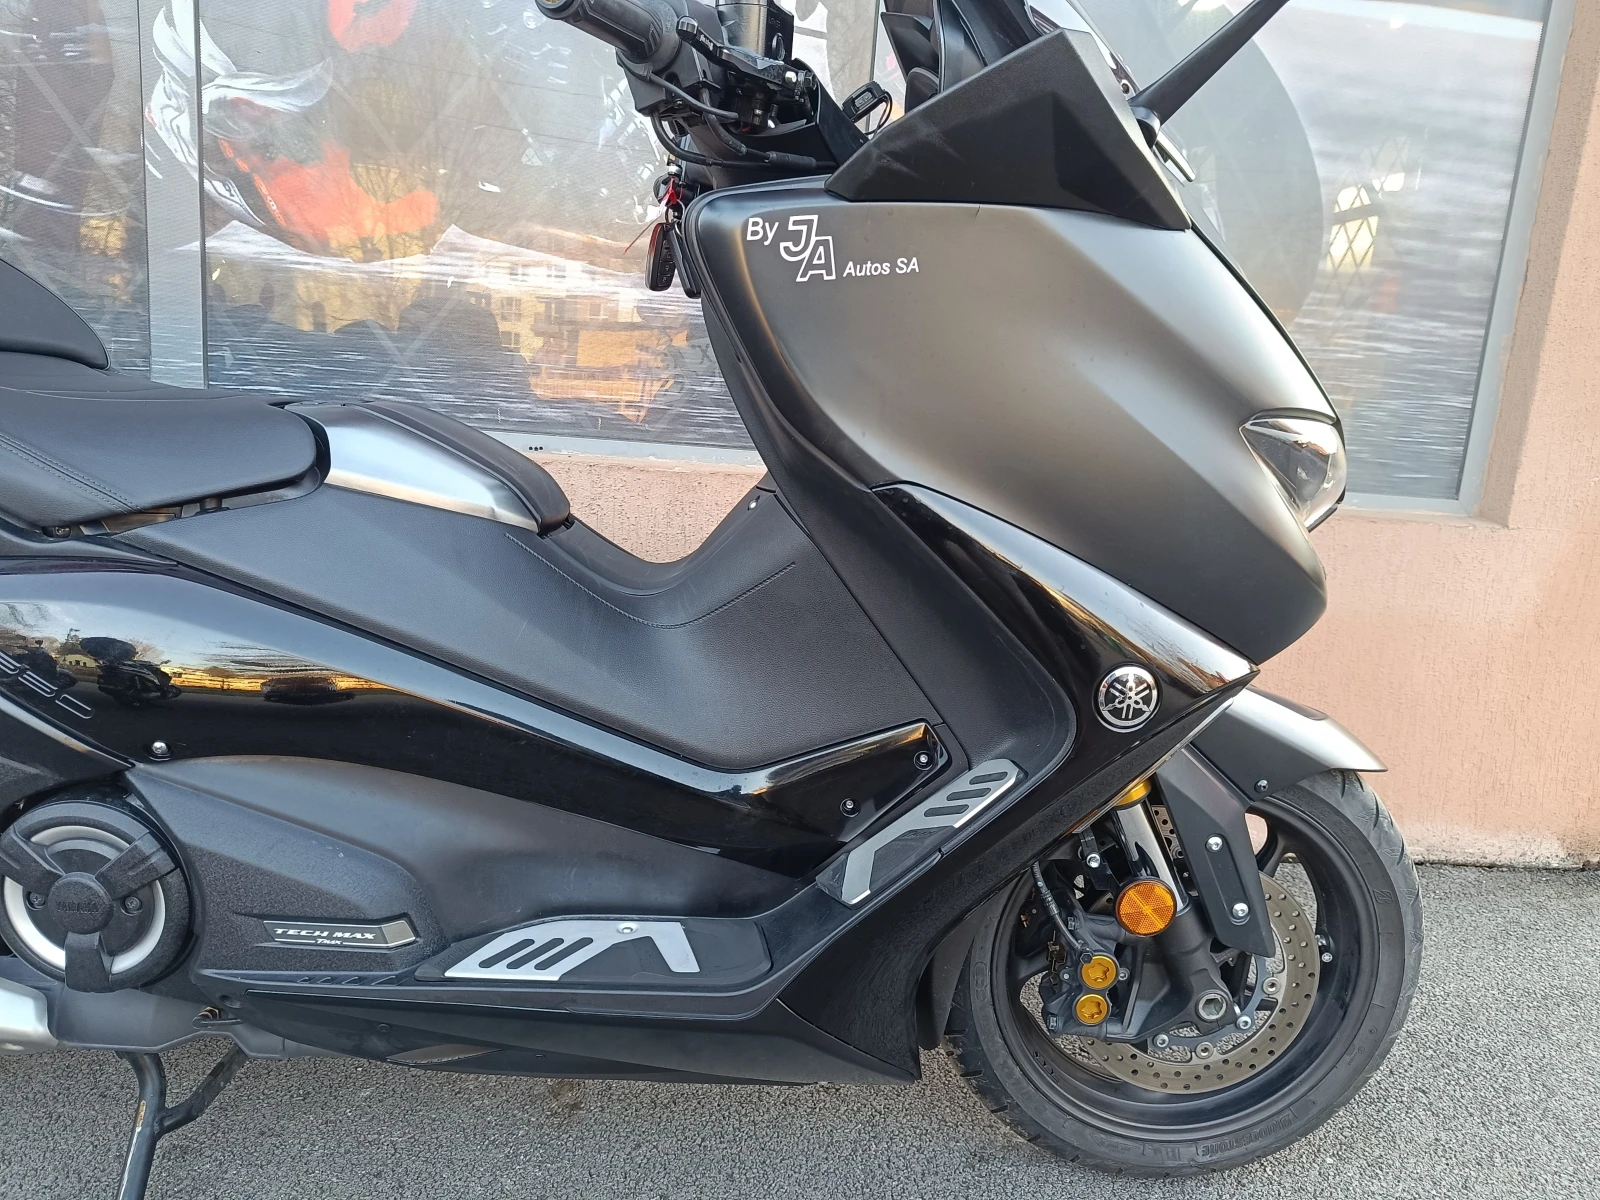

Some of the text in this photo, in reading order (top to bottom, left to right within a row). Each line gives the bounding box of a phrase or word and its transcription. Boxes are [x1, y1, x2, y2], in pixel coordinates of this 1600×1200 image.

[747, 215, 919, 282] By JA Autos SA
[273, 928, 377, 940] TECH MAX
